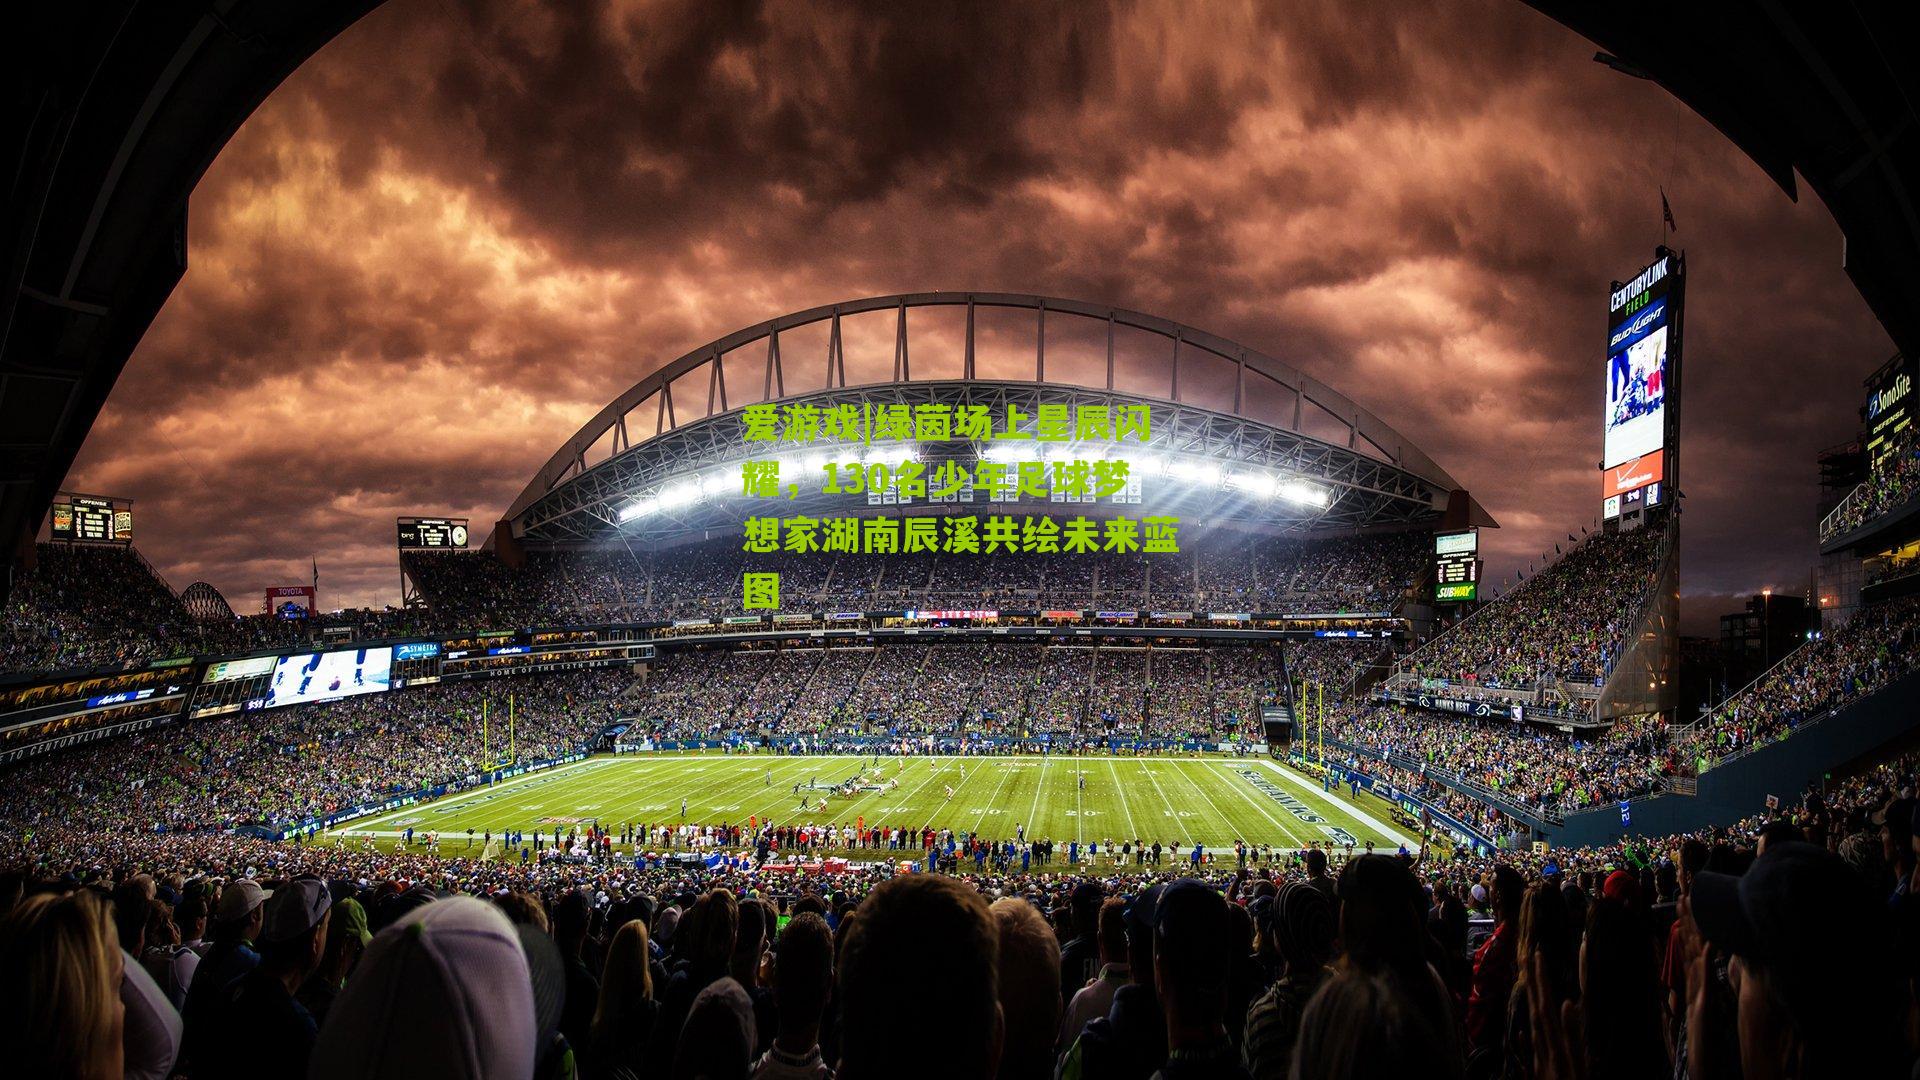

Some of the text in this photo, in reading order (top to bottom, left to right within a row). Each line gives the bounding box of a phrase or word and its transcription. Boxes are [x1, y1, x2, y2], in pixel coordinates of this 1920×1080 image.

[1625, 290, 1650, 316] FIELD
[1610, 305, 1665, 347] BUD LIGHT
[1876, 373, 1912, 414] SonoSite
[1872, 407, 1905, 435] DEFENSE
[80, 499, 107, 507] OFFENSE
[278, 587, 304, 596] TOYOTA
[1437, 584, 1475, 599] SUBWAY
[410, 643, 438, 653] SYMETRA
[490, 659, 609, 677] HOME OF THE 12TH MAN
[9, 752, 23, 762] TO
[118, 720, 153, 735] FIELD
[1620, 805, 1630, 822] 12
